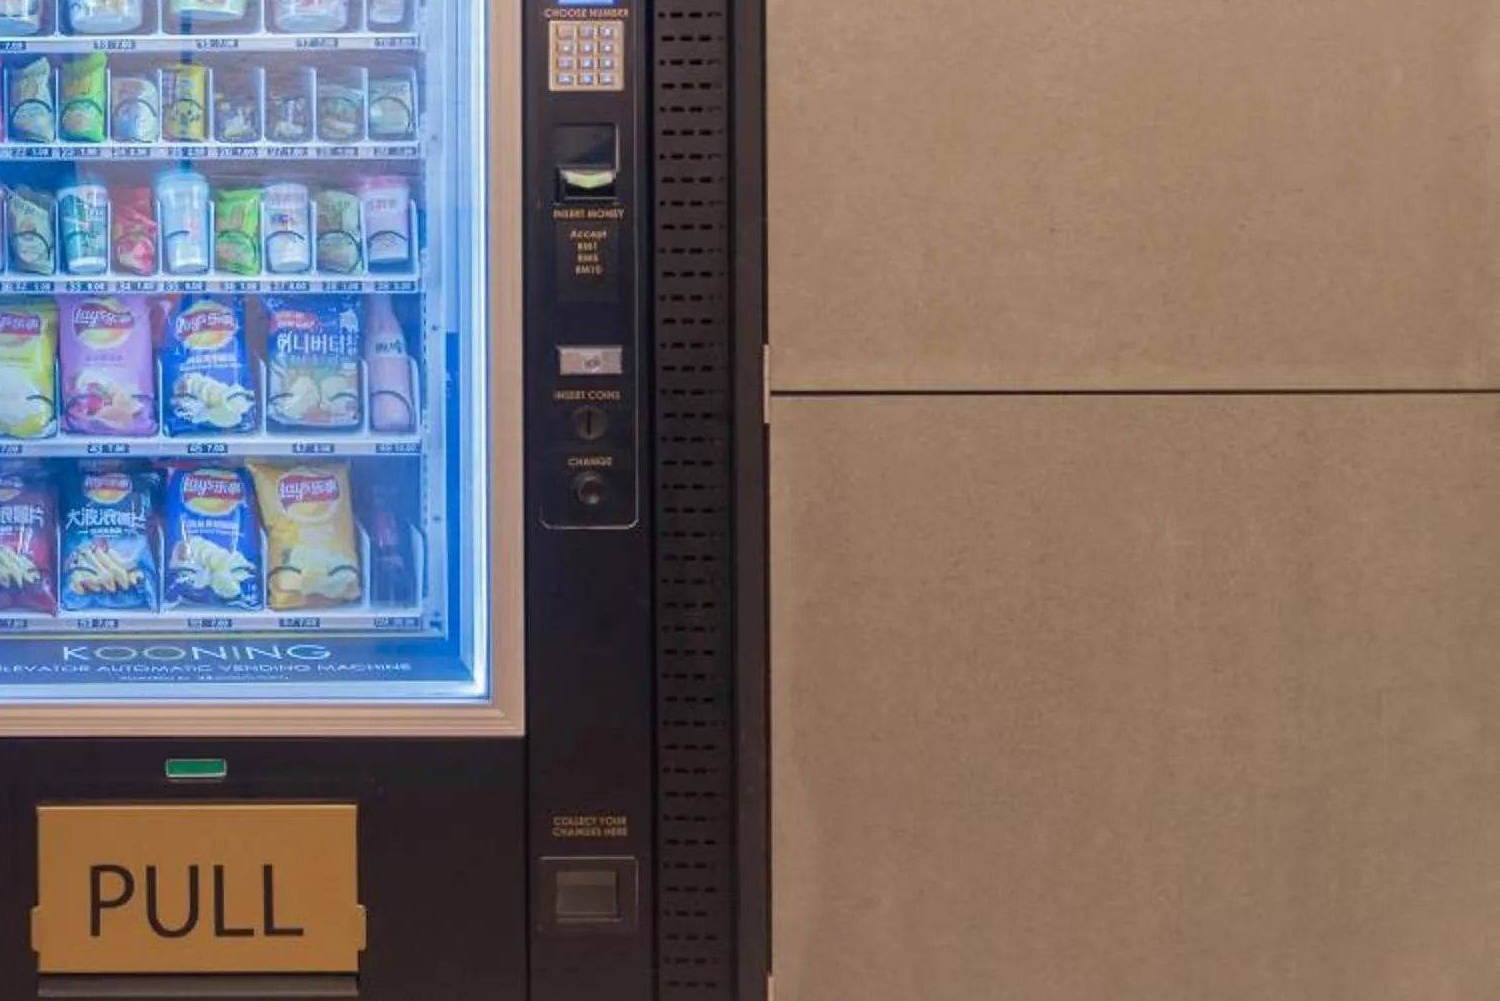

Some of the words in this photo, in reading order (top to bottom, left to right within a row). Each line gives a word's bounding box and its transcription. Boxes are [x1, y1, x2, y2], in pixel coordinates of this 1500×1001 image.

[544, 8, 587, 17] CHOOSE
[589, 8, 628, 17] NUMBER
[568, 456, 612, 466] CHANGE
[63, 644, 331, 660] KOONING
[97, 664, 213, 672] AUTOMATIC
[222, 664, 310, 672] VENDING
[318, 663, 411, 671] MACHINE
[89, 864, 304, 939] PULL
